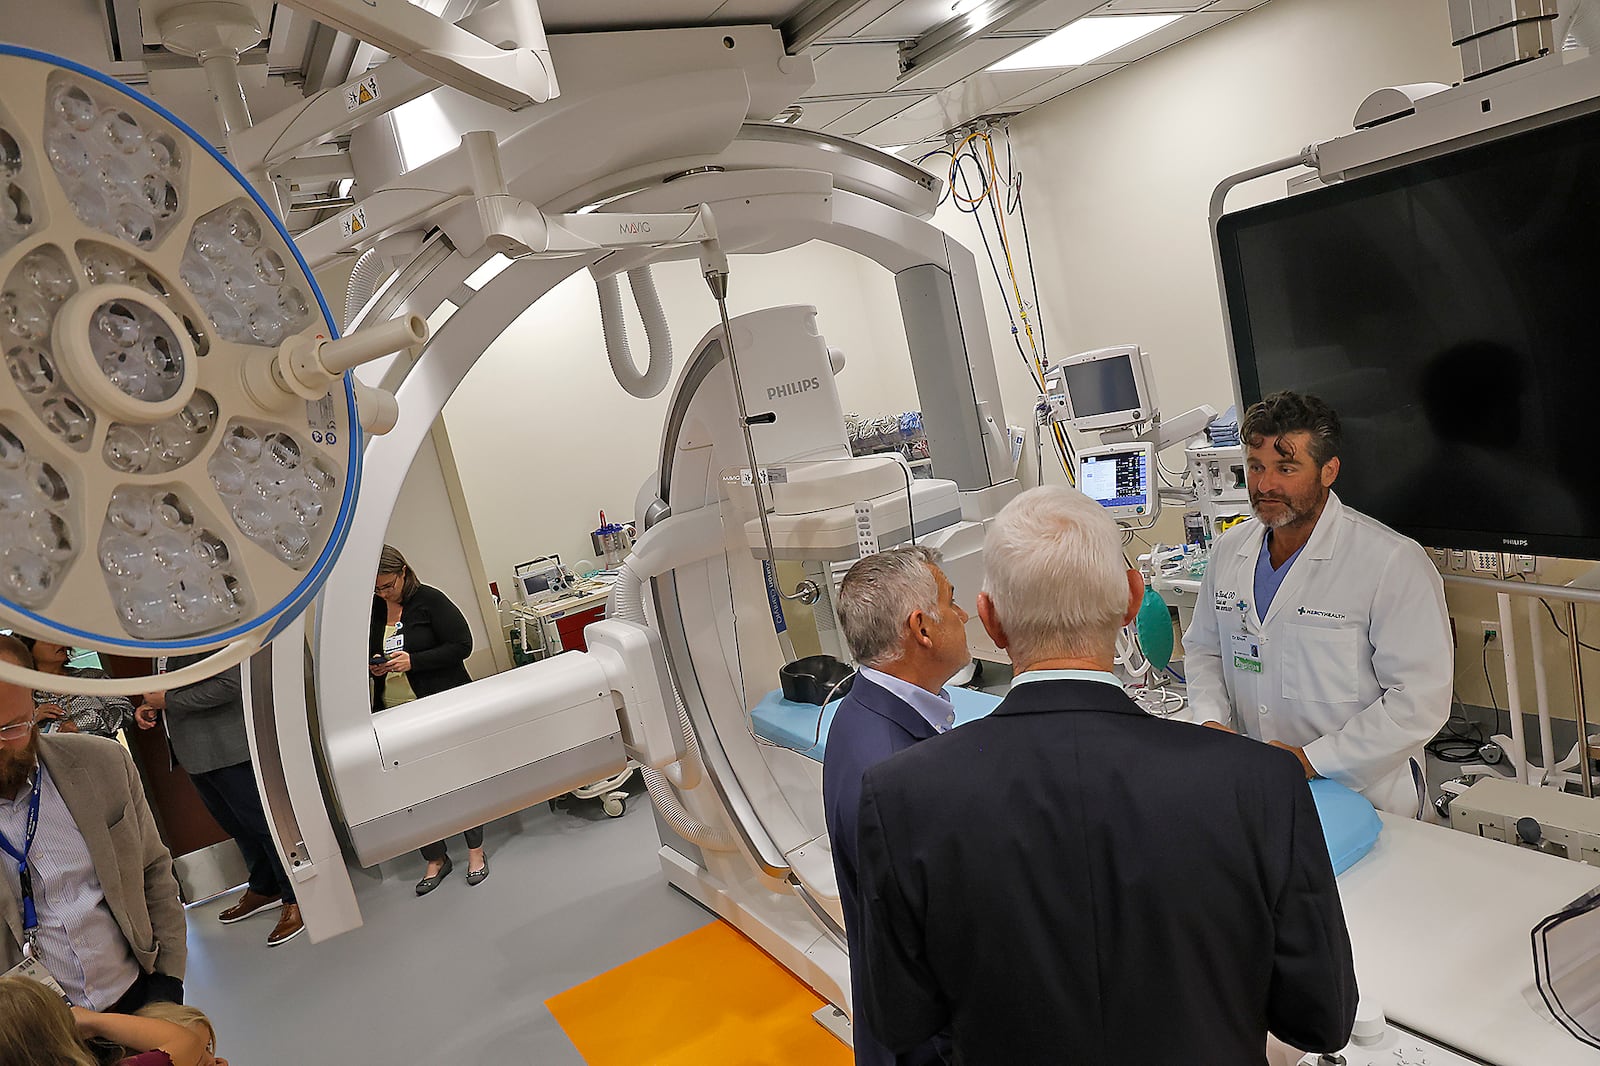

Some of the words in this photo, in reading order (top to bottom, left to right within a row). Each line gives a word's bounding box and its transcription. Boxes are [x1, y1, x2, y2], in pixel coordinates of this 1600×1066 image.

[619, 221, 651, 234] MAVIG
[766, 376, 820, 400] PHILIPS
[1502, 538, 1529, 547] PHILIPS
